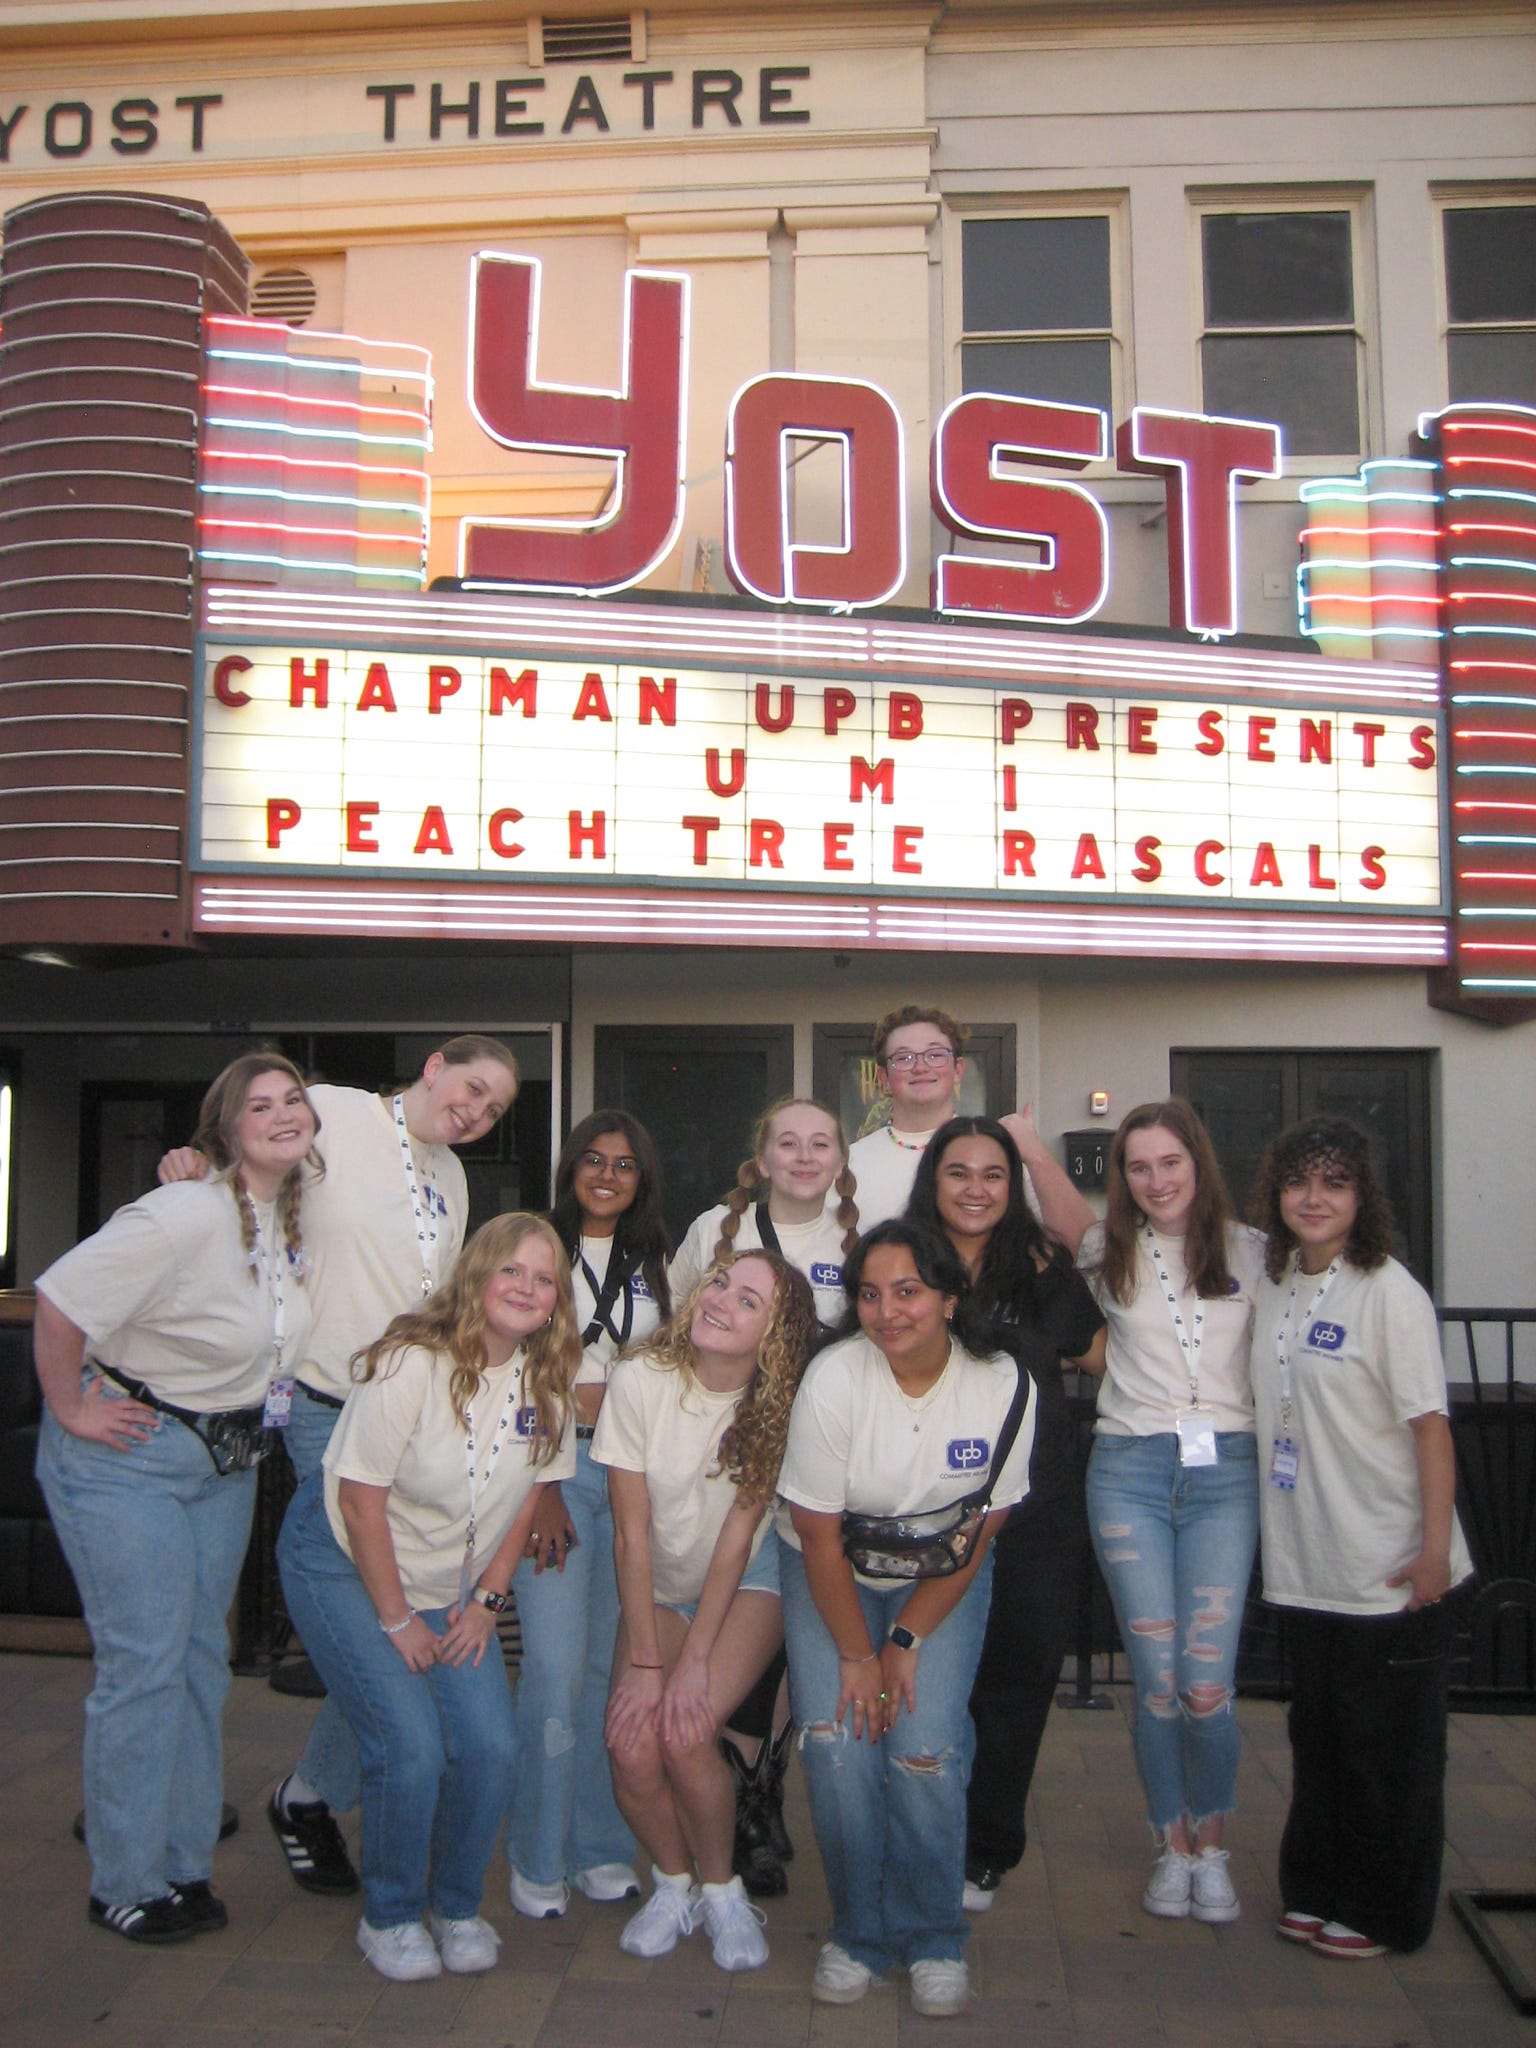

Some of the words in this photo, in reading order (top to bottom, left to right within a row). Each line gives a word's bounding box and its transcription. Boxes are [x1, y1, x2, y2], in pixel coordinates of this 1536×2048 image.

[0, 94, 223, 163] YOST
[366, 66, 811, 143] THEATRE
[458, 249, 1283, 641] YOST
[213, 654, 677, 727] CHAPMAN
[755, 683, 925, 742] UPB
[1001, 697, 1438, 771] PRESENTS
[266, 799, 607, 860] PEACH
[682, 816, 925, 875] TREE
[1002, 828, 1387, 891] RASCALS
[953, 1439, 982, 1469] upb
